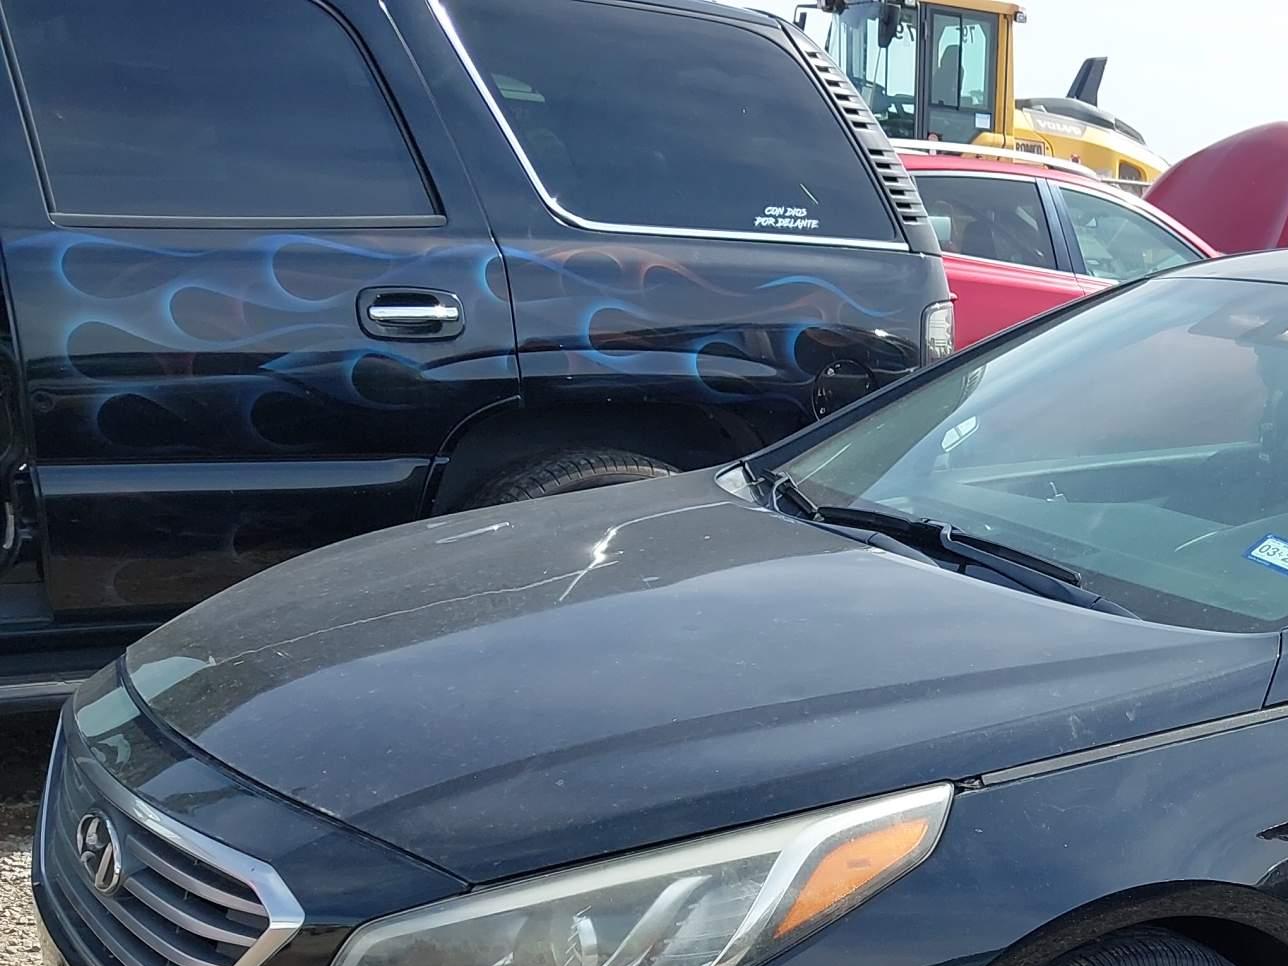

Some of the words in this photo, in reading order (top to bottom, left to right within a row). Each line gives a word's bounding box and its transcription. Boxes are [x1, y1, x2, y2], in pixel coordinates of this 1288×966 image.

[1036, 119, 1082, 135] VOLVO
[764, 206, 784, 216] CON
[785, 207, 807, 217] DIOS
[754, 216, 775, 227] POR
[776, 218, 819, 229] DELANTE
